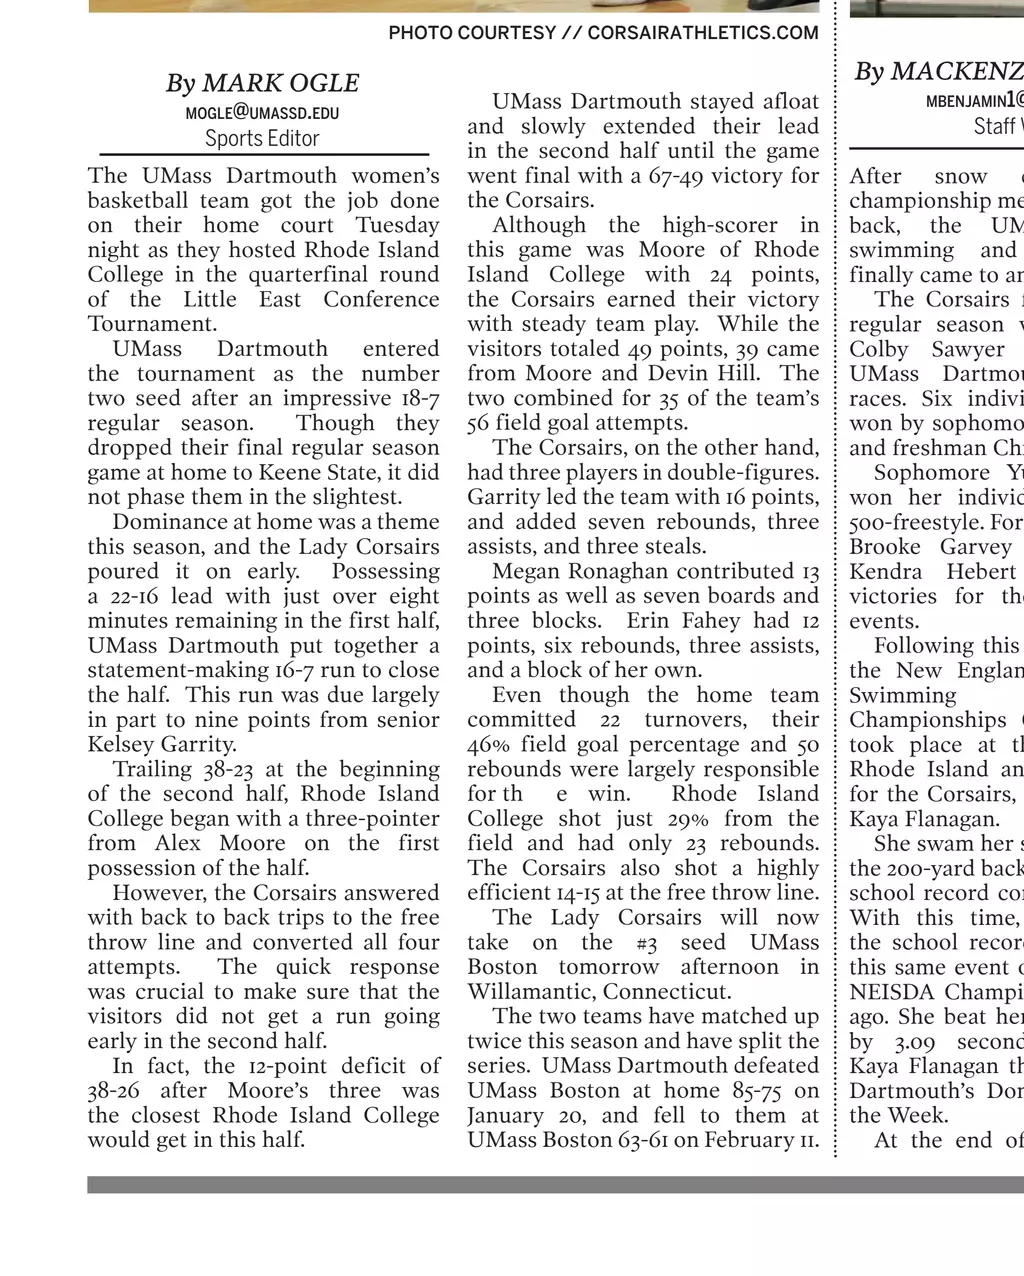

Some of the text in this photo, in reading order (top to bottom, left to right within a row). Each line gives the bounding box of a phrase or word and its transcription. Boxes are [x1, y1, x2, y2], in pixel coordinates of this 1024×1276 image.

[390, 25, 818, 39] PHOTO COURTESY // CORSAIRATHLETICS.COM
[855, 62, 884, 85] By
[166, 73, 359, 97] By MARK OGLE
[186, 102, 338, 119] MOGLE@UMASSD.EDU
[493, 92, 819, 113] UMass Dartmouth stayed afloat
[975, 117, 1015, 134] Staff
[206, 129, 320, 150] Sports Editor
[88, 166, 127, 183] The
[143, 167, 211, 183] UMass
[227, 166, 337, 183] Dartmouth
[850, 167, 901, 184] After
[936, 172, 987, 184] snow
[88, 735, 236, 756] Kelsey Garrity.
[850, 810, 999, 831] Kaya Flanagan.
[468, 1130, 819, 1152] UMass Boston 63-61 on February 11.
